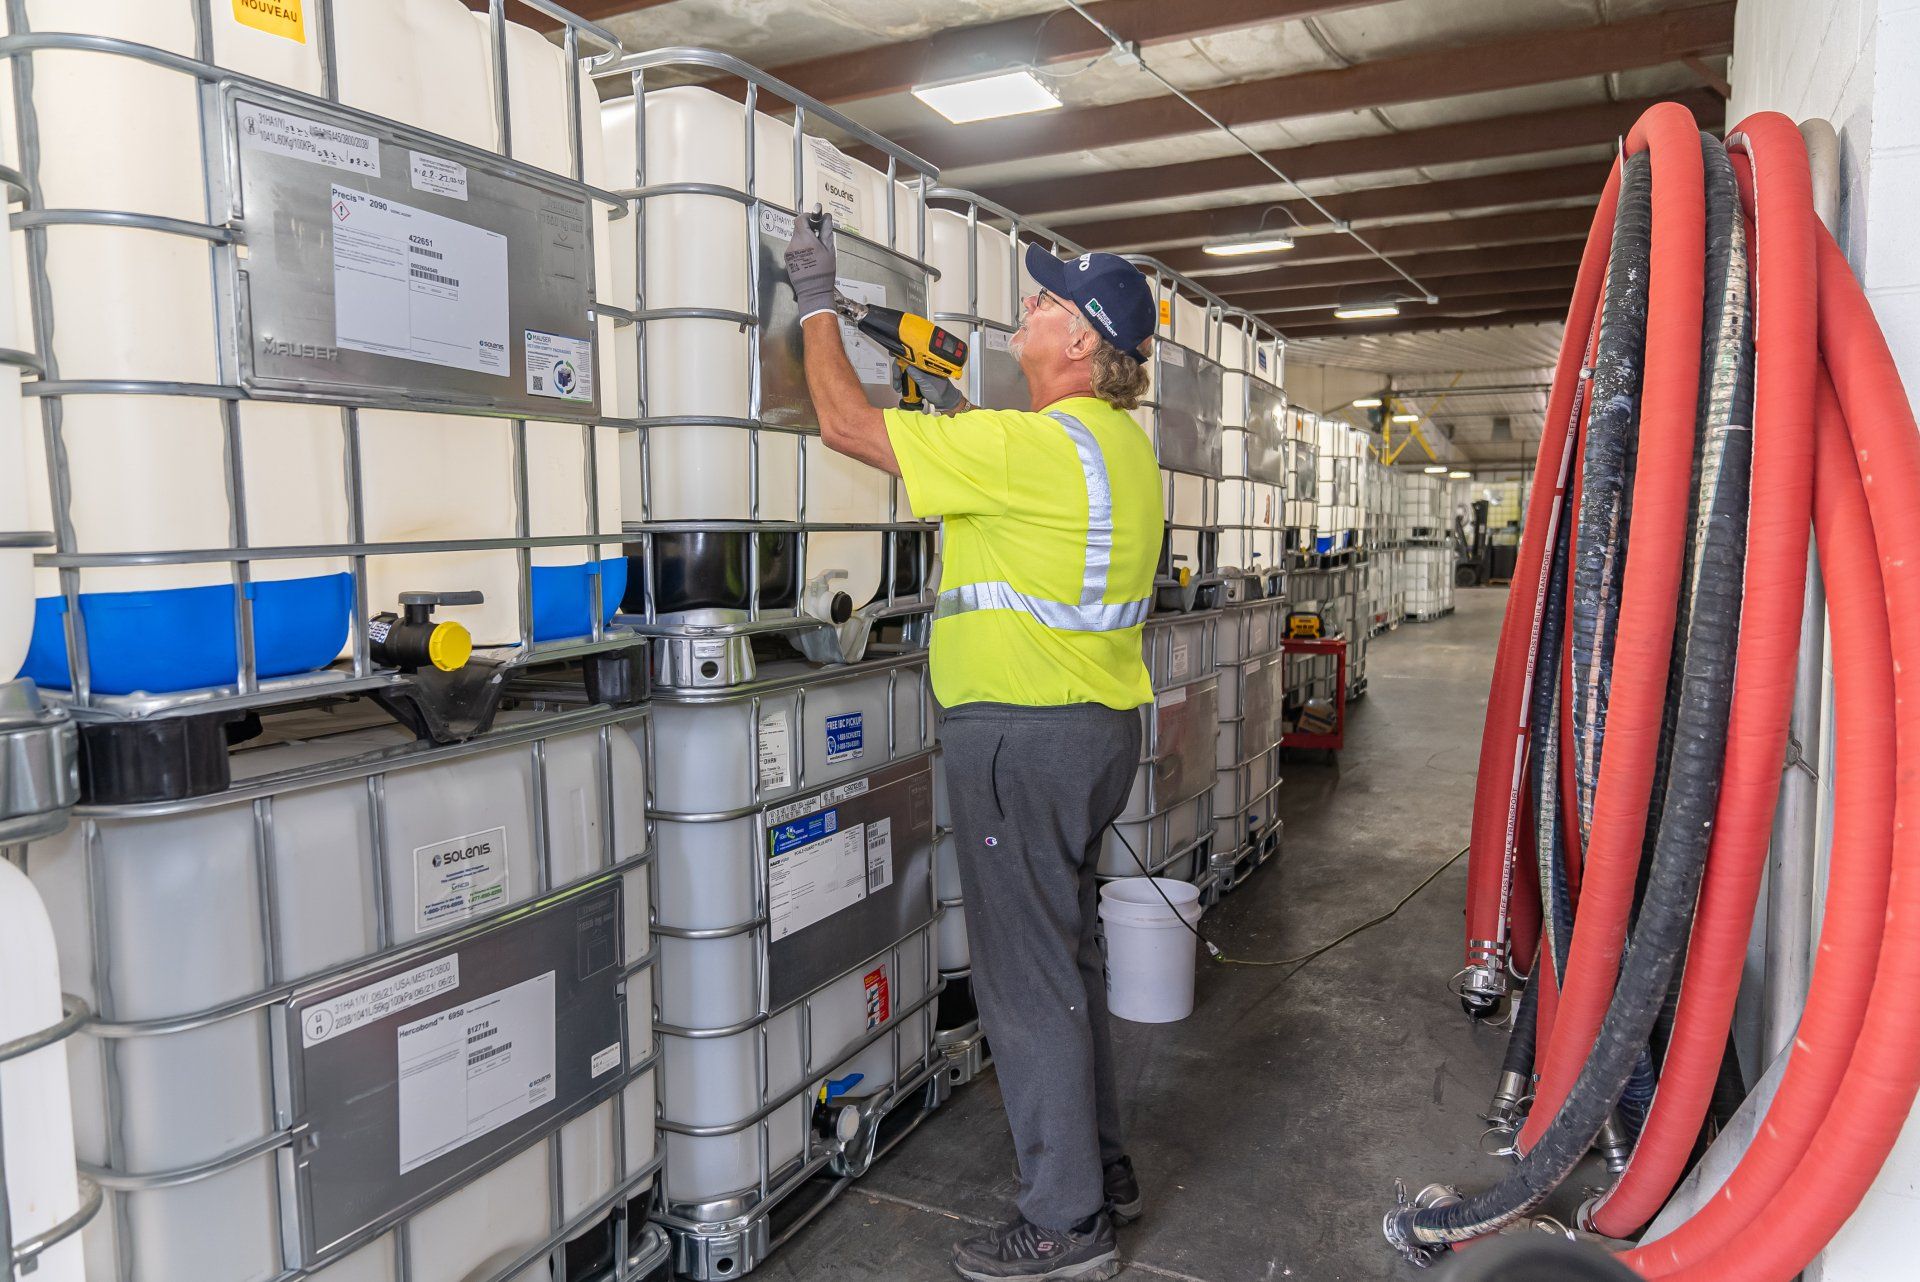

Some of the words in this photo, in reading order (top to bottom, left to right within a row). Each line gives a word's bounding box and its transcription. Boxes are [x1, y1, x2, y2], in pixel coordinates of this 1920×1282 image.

[241, 0, 297, 22] NOUVEAU
[332, 188, 365, 203] Precis™
[369, 199, 388, 211] 2090
[408, 234, 433, 247] 422651
[1571, 382, 1585, 417] FOSTER
[1568, 420, 1577, 440] JEFF
[1538, 549, 1551, 597] TRANSPORT
[1535, 600, 1543, 623] BULK
[1530, 624, 1539, 657] FOSTER
[827, 720, 838, 730] FREE
[846, 717, 861, 728] PICKUP
[1502, 863, 1510, 895] FOSTER
[1508, 788, 1517, 837] TRANSPORT
[444, 843, 490, 865] SOLENIS
[399, 1016, 444, 1038] Hercobond™
[448, 1009, 464, 1020] 6950
[467, 1021, 489, 1035] 812718
